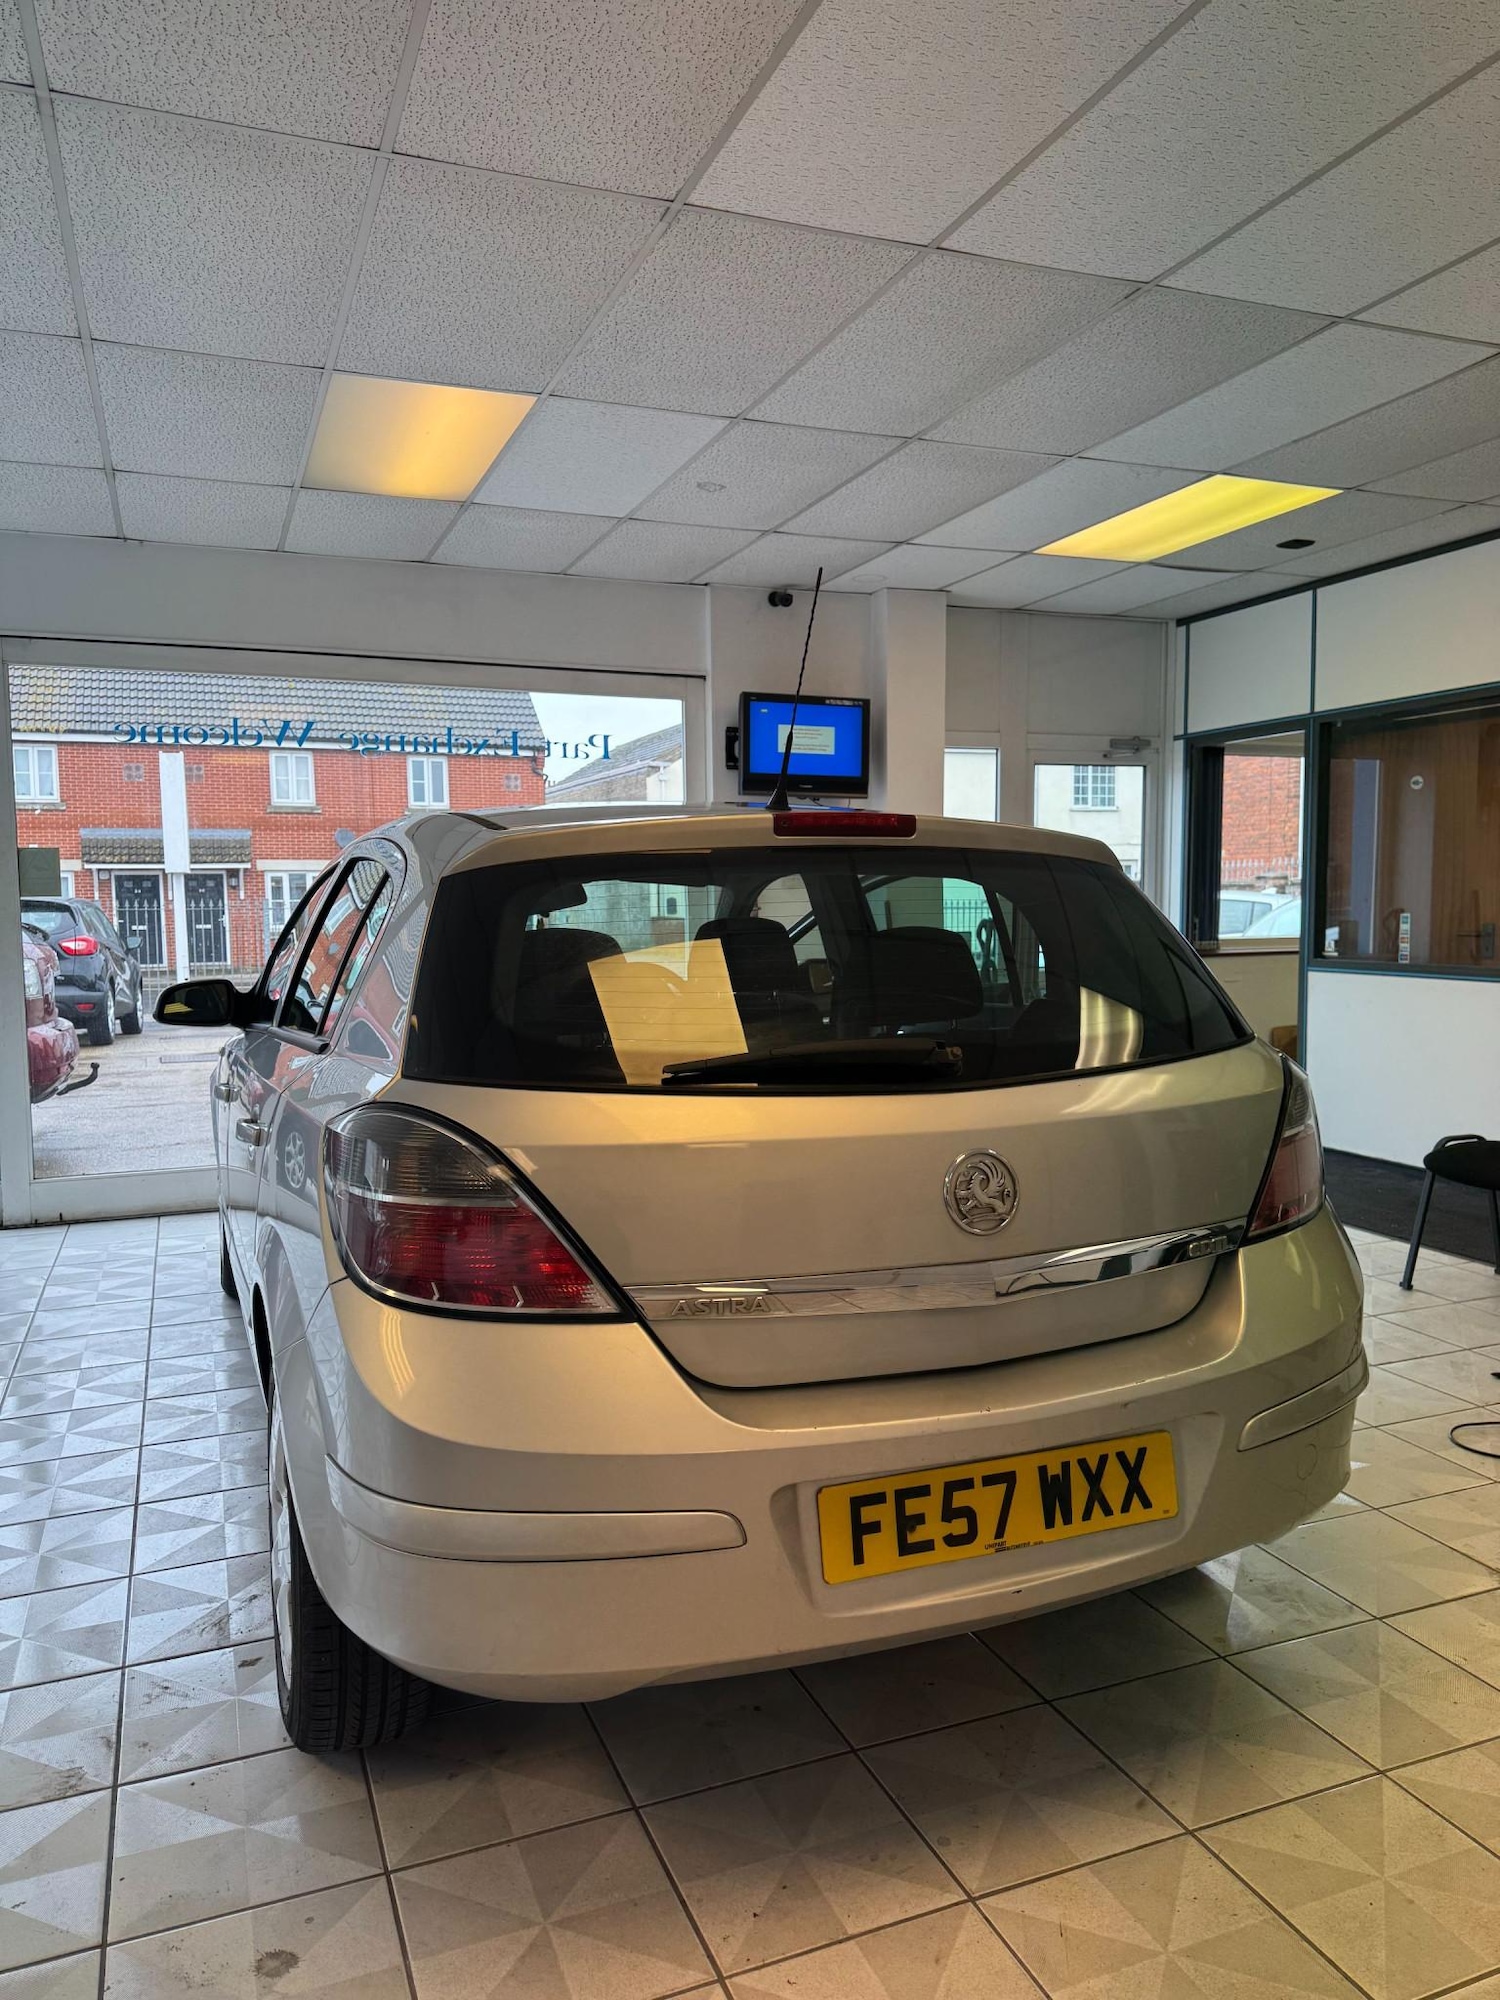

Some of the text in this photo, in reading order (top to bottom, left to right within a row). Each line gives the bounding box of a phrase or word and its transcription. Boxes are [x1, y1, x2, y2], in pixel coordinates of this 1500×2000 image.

[671, 1296, 771, 1316] ASTRA
[849, 1446, 1153, 1566] FE57 WXX
